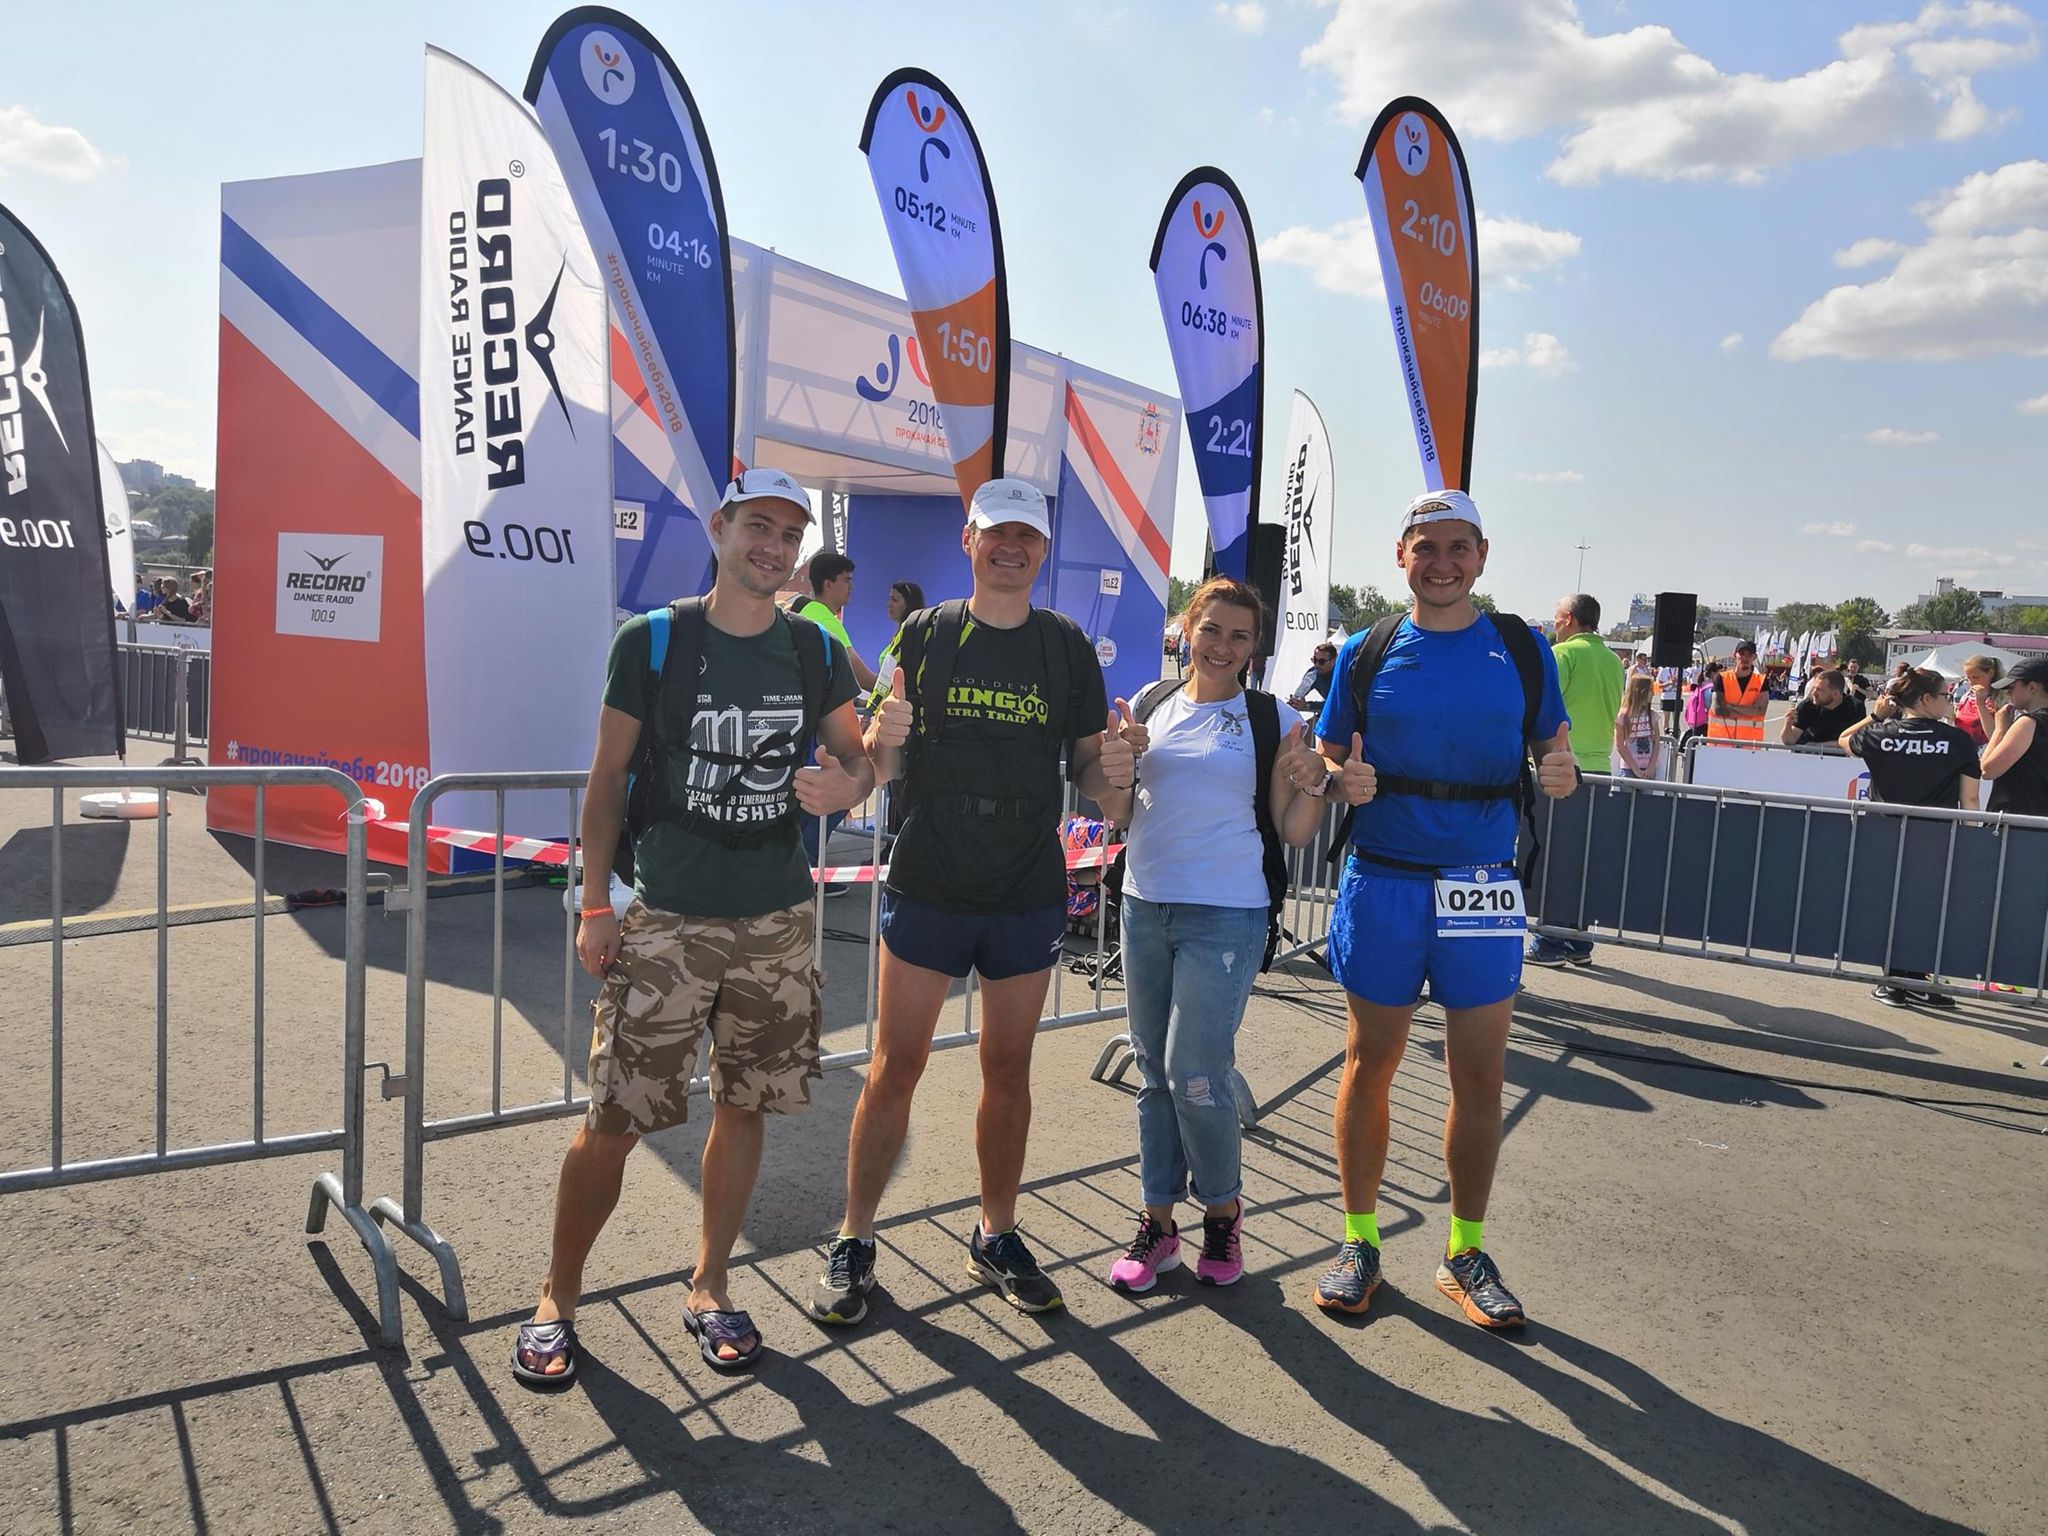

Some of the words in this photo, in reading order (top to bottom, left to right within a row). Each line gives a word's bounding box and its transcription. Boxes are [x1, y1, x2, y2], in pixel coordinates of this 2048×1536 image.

[598, 127, 682, 193] 1:30
[895, 186, 946, 232] 05:12
[951, 213, 977, 233] MINUTE
[1401, 199, 1457, 256] 2:10
[951, 228, 961, 240] KM
[647, 223, 713, 269] 04:16
[646, 254, 685, 276] MINUTE
[646, 270, 661, 284] KM
[1420, 282, 1469, 322] 06:09
[1181, 301, 1227, 336] 06:38
[1231, 315, 1252, 330] MINUTE
[607, 253, 682, 433] #прокачайсебя2018
[1231, 329, 1240, 340] KM
[937, 321, 992, 374] 1:50
[1394, 304, 1435, 462] #прокачайсебя2018
[895, 427, 937, 445] ПРОКАЧАЙ
[286, 572, 366, 593] RECORD
[293, 592, 325, 603] DANCE
[326, 594, 354, 605] RADIO
[310, 608, 336, 624] 100.9
[952, 676, 1028, 692] GOLDEN
[946, 707, 981, 718] LTRA
[1012, 694, 1048, 717] 100
[1880, 738, 1950, 755] СУДЬЯ
[1448, 889, 1515, 911] 0210
